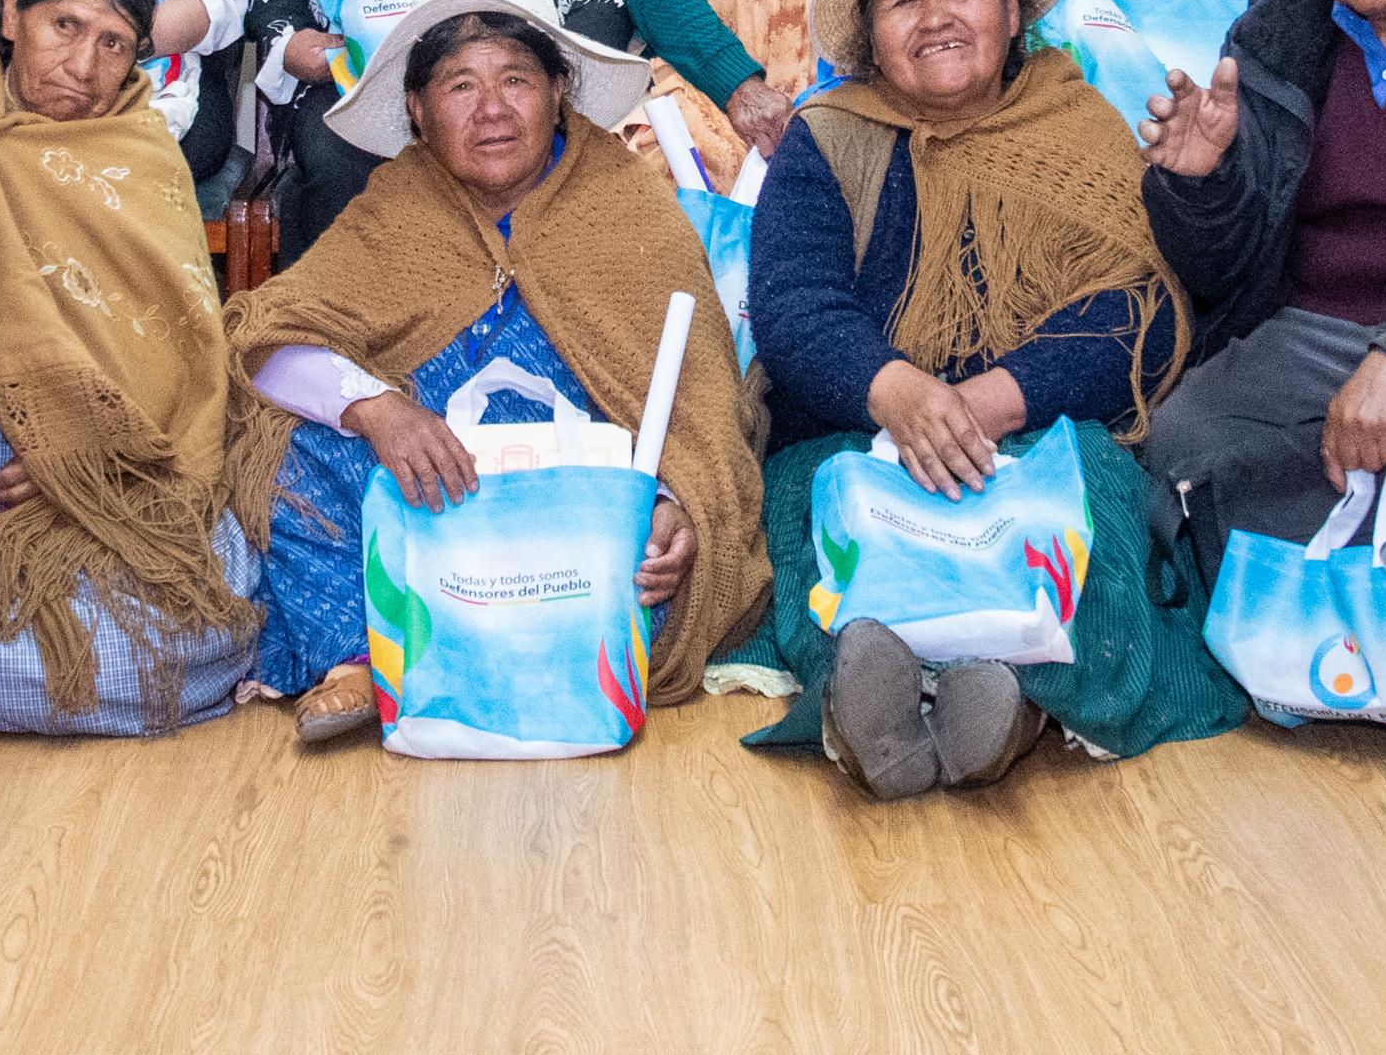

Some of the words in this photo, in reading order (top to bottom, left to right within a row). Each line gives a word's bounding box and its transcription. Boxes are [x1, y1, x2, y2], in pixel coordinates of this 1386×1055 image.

[451, 572, 486, 586] Todas
[489, 577, 497, 588] y
[500, 573, 535, 586] todos
[539, 568, 578, 581] somos
[439, 578, 515, 599] Defensores
[518, 585, 539, 596] del
[543, 579, 591, 594] Pueblo
